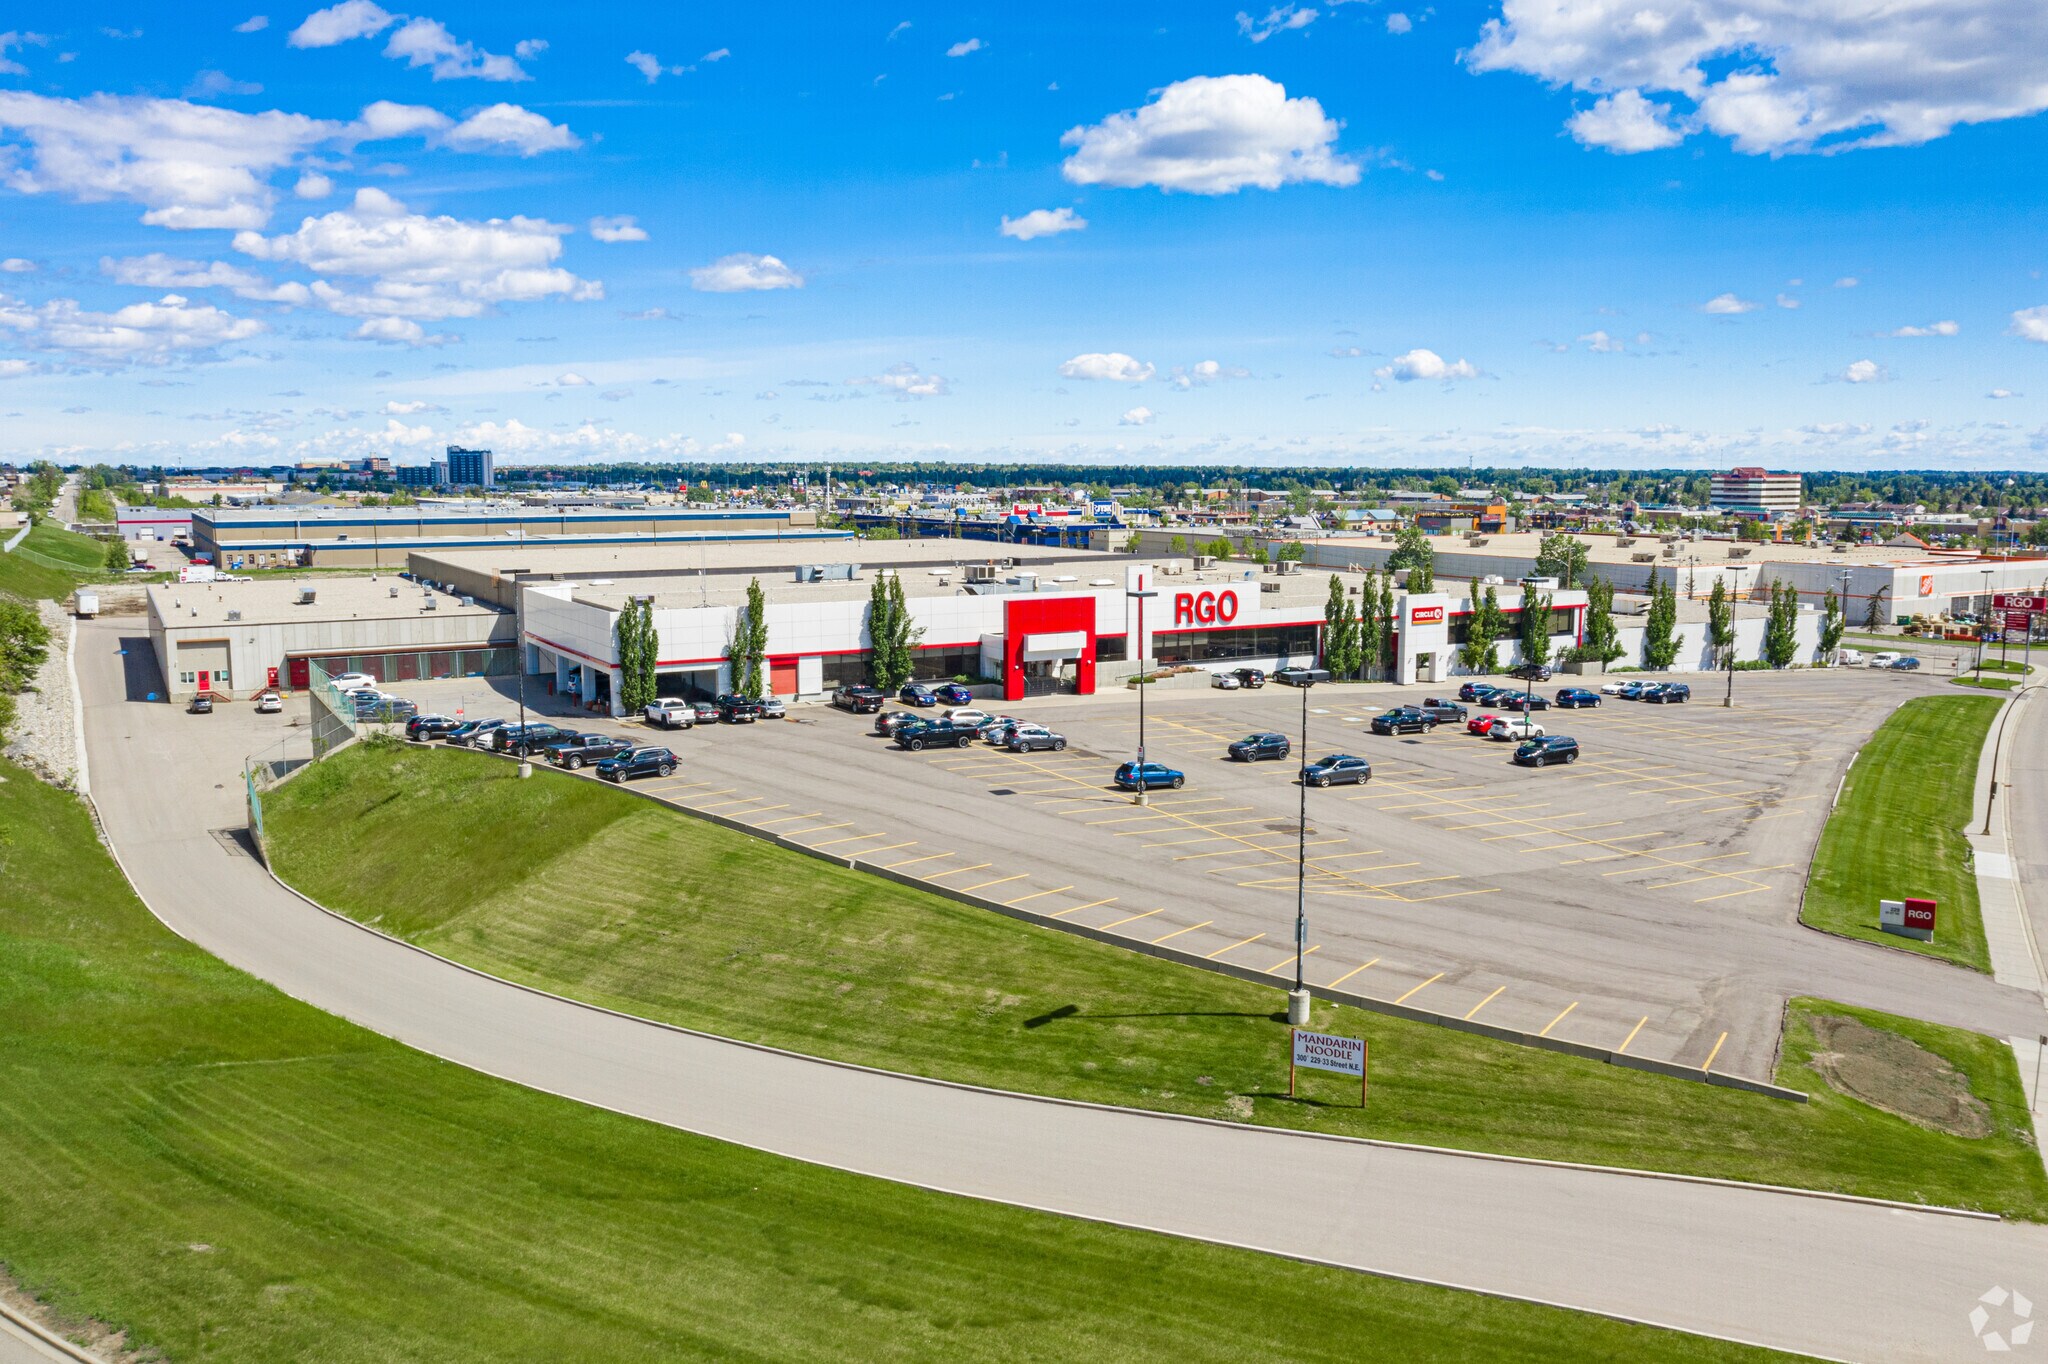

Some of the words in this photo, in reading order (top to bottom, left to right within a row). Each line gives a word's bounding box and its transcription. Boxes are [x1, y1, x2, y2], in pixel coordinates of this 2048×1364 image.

[1175, 590, 1239, 624] RGO
[2004, 596, 2033, 608] RGO
[1908, 910, 1932, 920] RGO
[1298, 1033, 1361, 1051] MANDARIN
[1305, 1044, 1352, 1060] NOODLE
[1330, 1058, 1348, 1069] Street
[1348, 1063, 1361, 1071] N.E.
